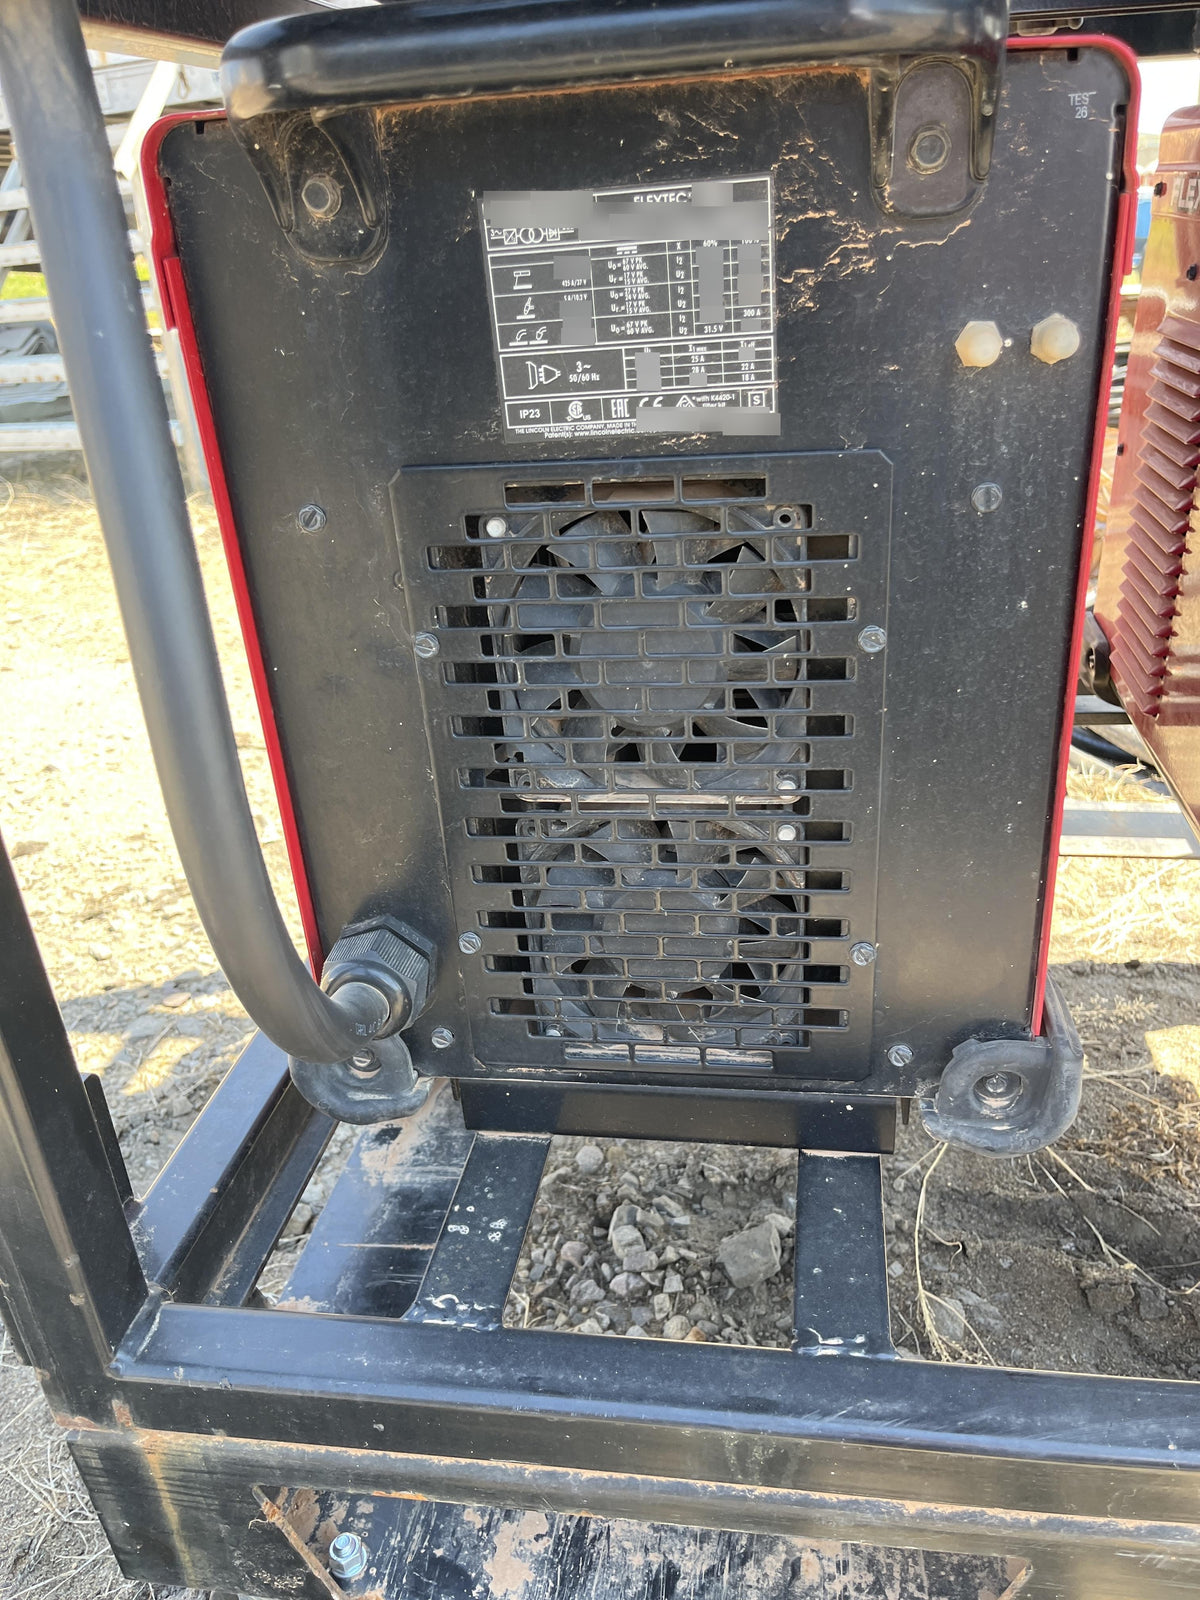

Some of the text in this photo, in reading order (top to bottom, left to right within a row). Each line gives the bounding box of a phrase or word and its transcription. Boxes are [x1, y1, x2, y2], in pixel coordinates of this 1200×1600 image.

[1074, 106, 1088, 119] 26
[703, 325, 718, 333] 31.5
[569, 372, 600, 383] 50/60 Hz
[752, 395, 761, 405] S
[519, 409, 541, 419] IP23
